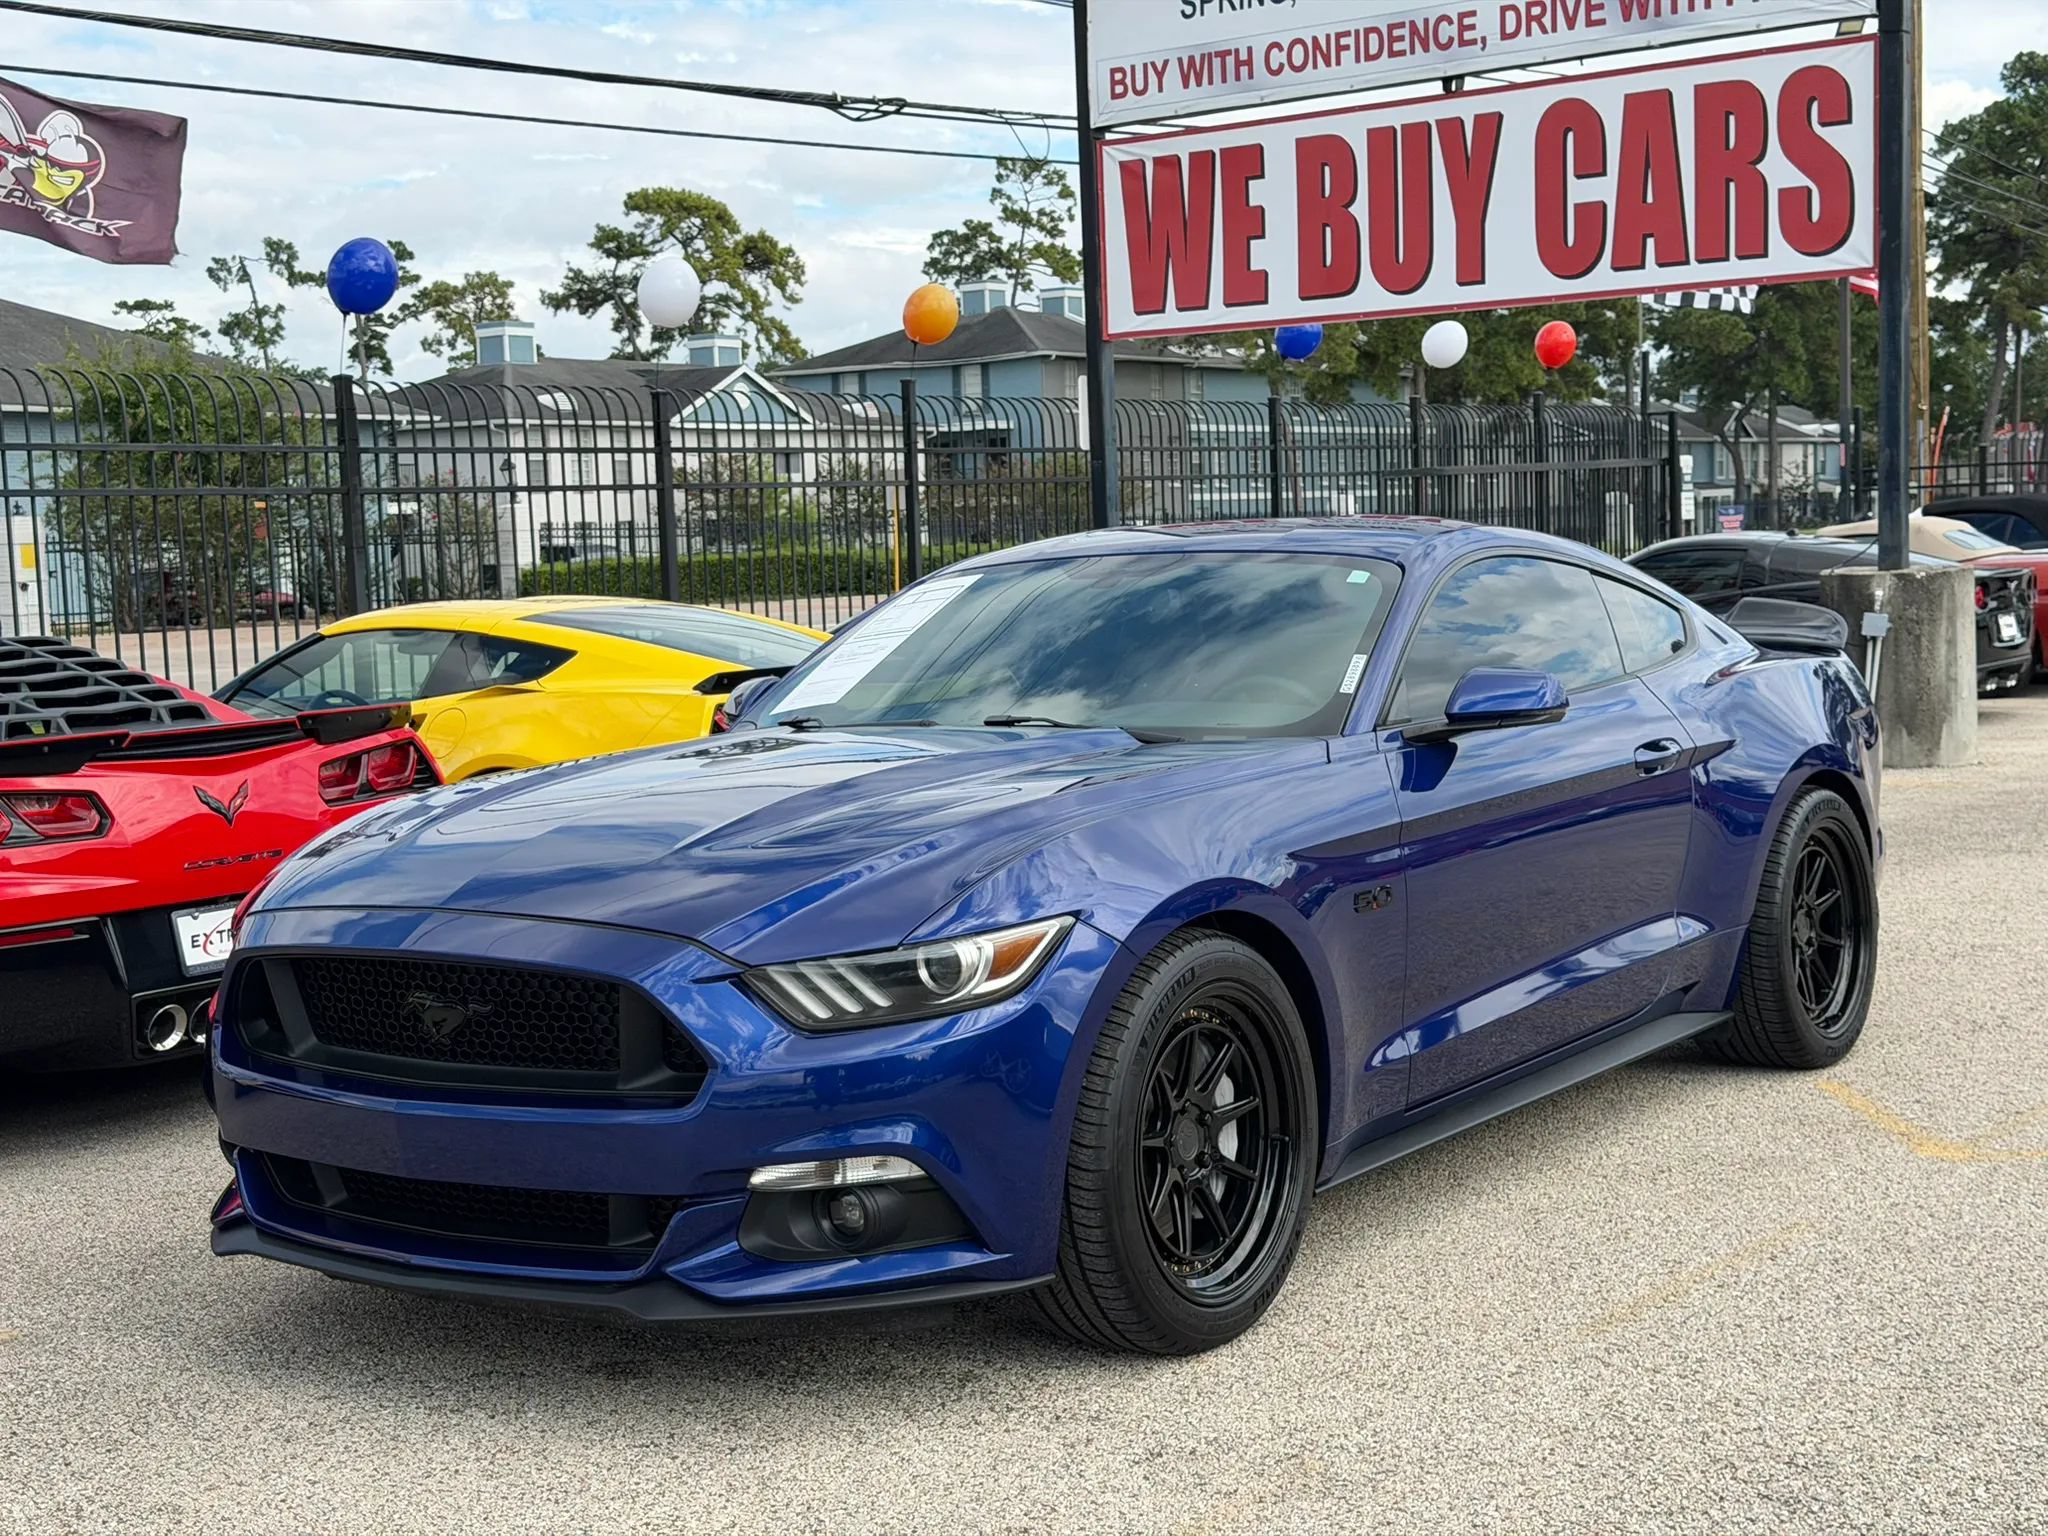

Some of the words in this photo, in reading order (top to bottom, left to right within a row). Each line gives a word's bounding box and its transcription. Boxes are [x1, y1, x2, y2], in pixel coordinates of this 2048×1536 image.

[1109, 59, 1170, 100] BUY
[1177, 46, 1254, 90] WITH
[1263, 10, 1488, 77] CONFIDENCE,
[1500, 0, 1607, 41] DRIVE
[1619, 0, 1712, 23] WI
[1119, 143, 1269, 315] WE
[1294, 111, 1503, 301] BUY
[1534, 64, 1855, 280] CARS
